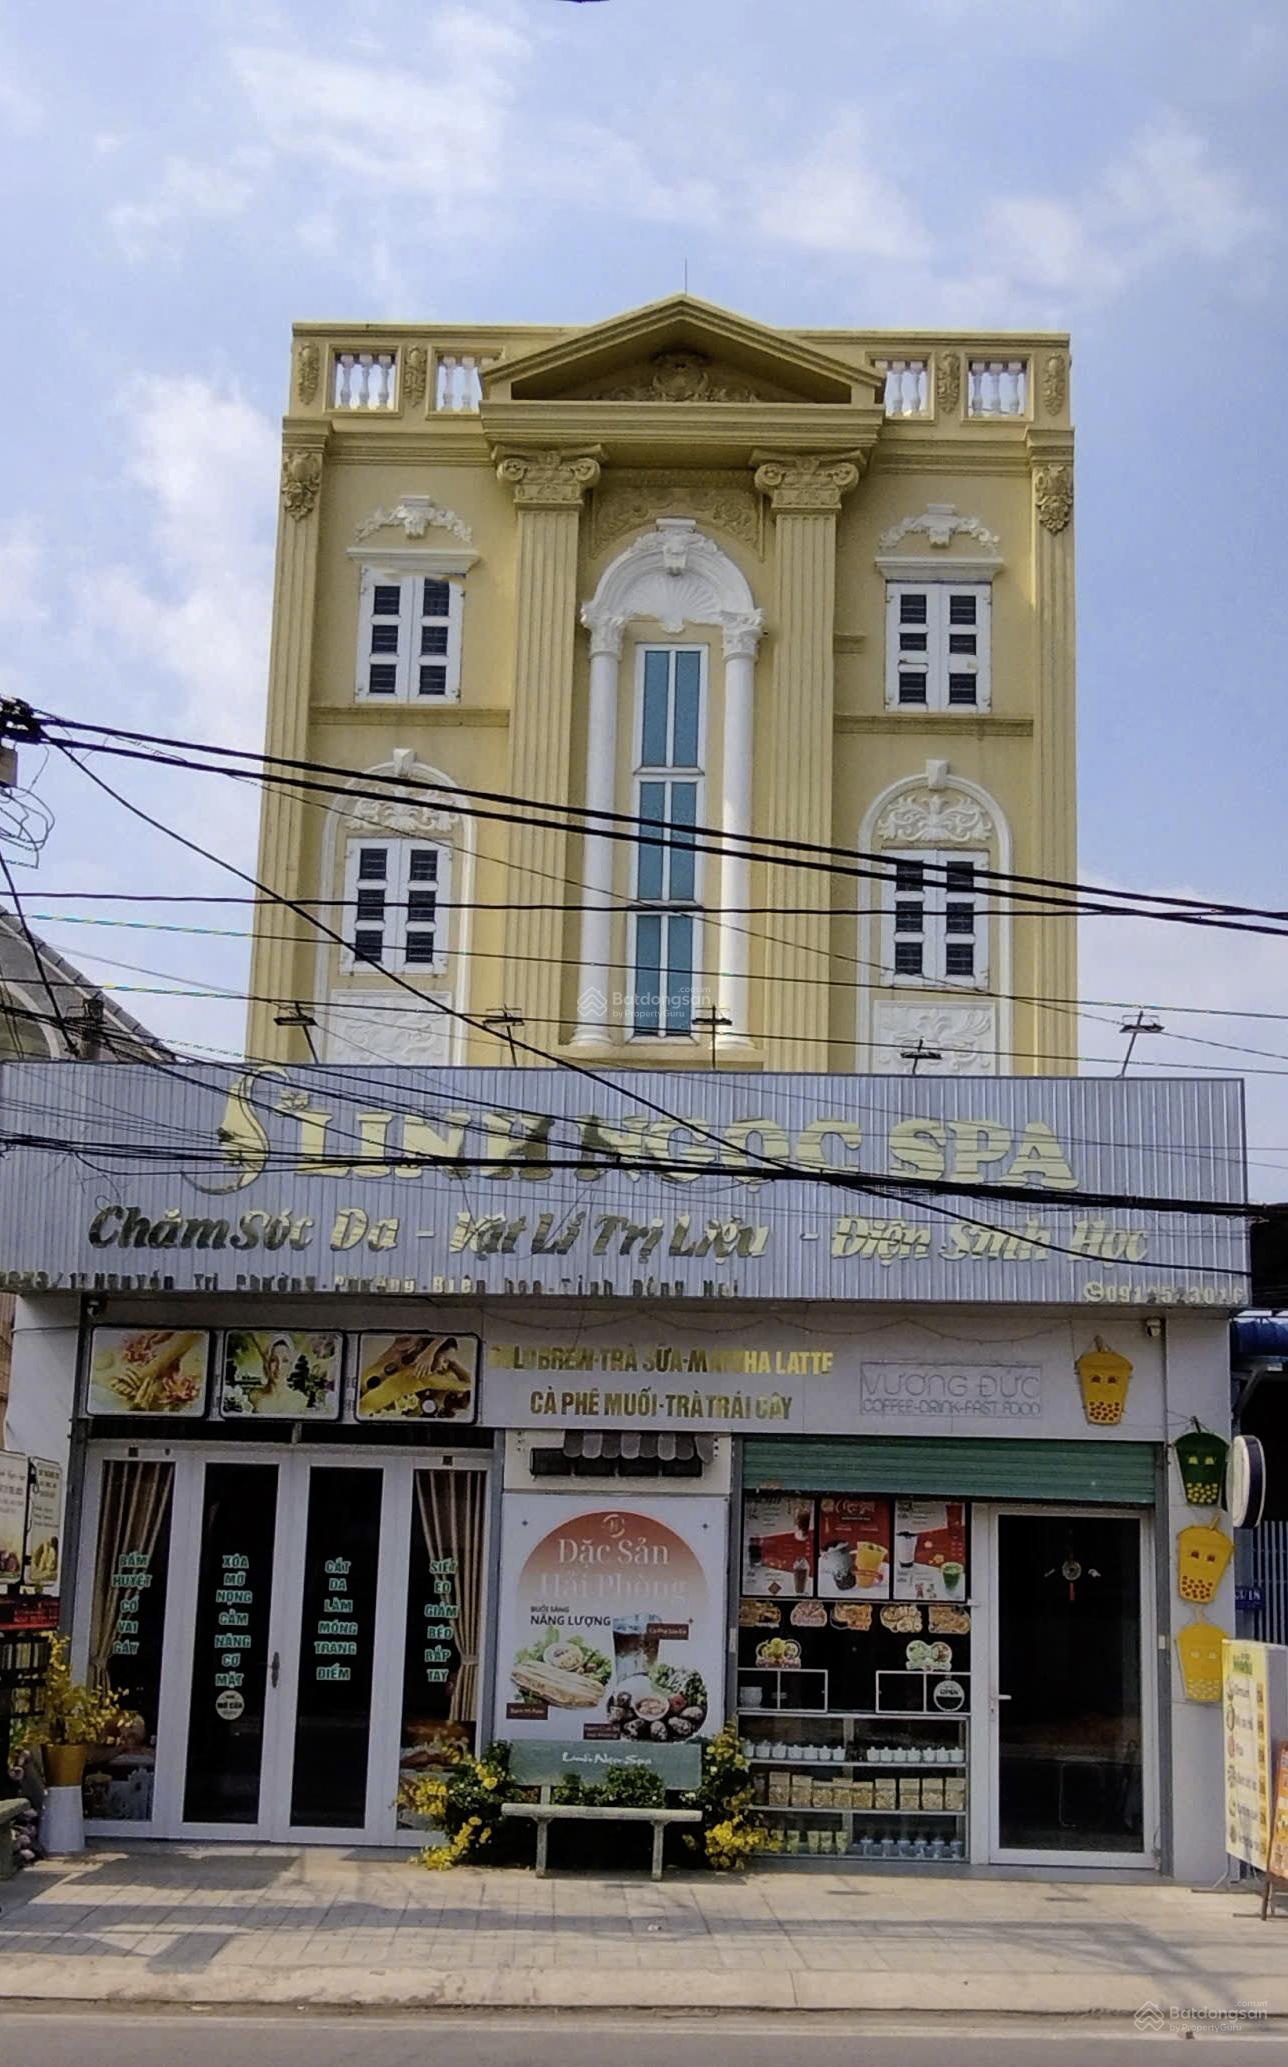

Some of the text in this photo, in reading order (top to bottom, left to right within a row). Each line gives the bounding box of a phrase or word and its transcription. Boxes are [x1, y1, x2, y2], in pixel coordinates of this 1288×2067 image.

[294, 1112, 554, 1181] LINH
[889, 1118, 1079, 1190] SPA
[229, 1207, 315, 1250] Sóc
[330, 1208, 400, 1251] Da
[593, 1213, 665, 1264] Trị
[776, 1350, 833, 1375] LATTE
[530, 1386, 557, 1415] CÀ
[562, 1387, 599, 1416] PHÊ
[706, 1390, 751, 1419] TRÁI
[756, 1391, 793, 1420] CÂY
[618, 1537, 670, 1565] Sản
[222, 1553, 249, 1569] XÓA
[329, 1578, 347, 1591] DA
[434, 1580, 451, 1593] EO
[216, 1590, 253, 1606] NỌNG
[117, 1620, 139, 1634] VAI
[318, 1619, 358, 1635] MÓNG
[568, 1615, 612, 1628] LƯỢNG
[314, 1641, 357, 1655] TRANG
[427, 1668, 449, 1682] TAY
